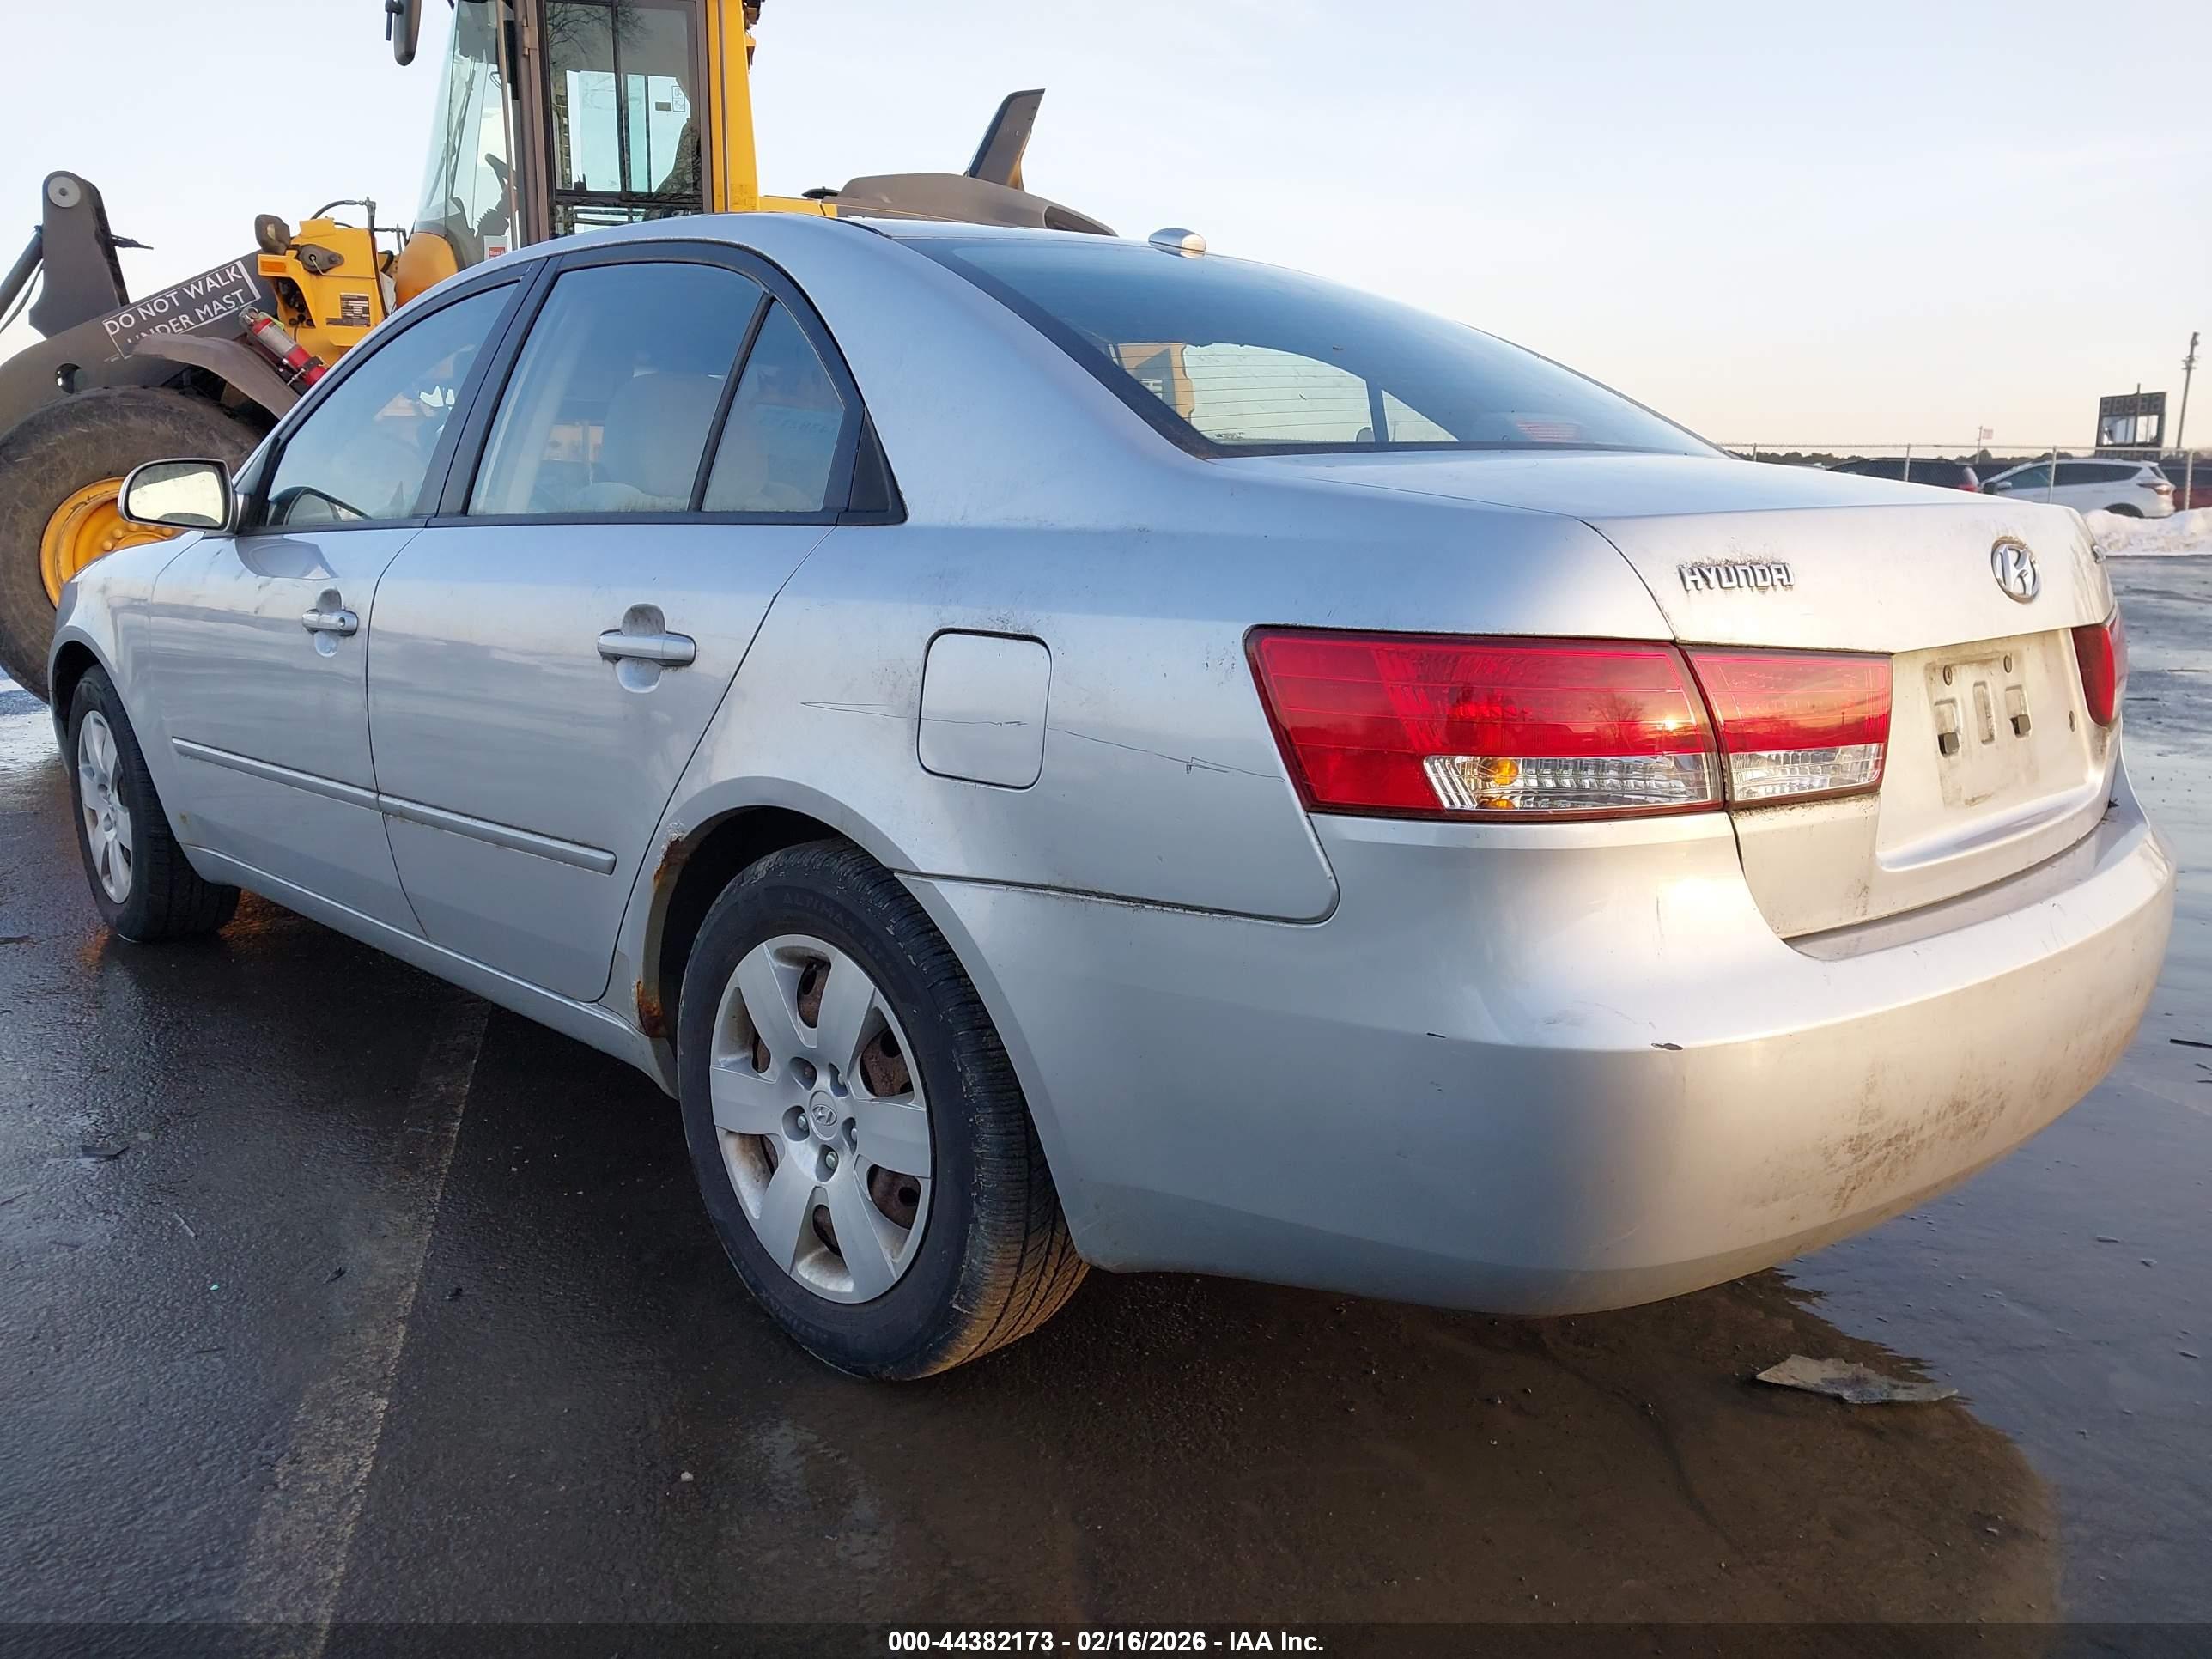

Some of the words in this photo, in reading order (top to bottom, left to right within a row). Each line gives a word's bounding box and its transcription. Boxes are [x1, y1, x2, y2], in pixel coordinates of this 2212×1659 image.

[103, 313, 136, 336] DO
[137, 291, 179, 321] NOT
[183, 265, 243, 299] WALK
[126, 314, 196, 343] DER
[194, 289, 246, 321] MAST
[1677, 562, 1795, 592] HYUNDAI
